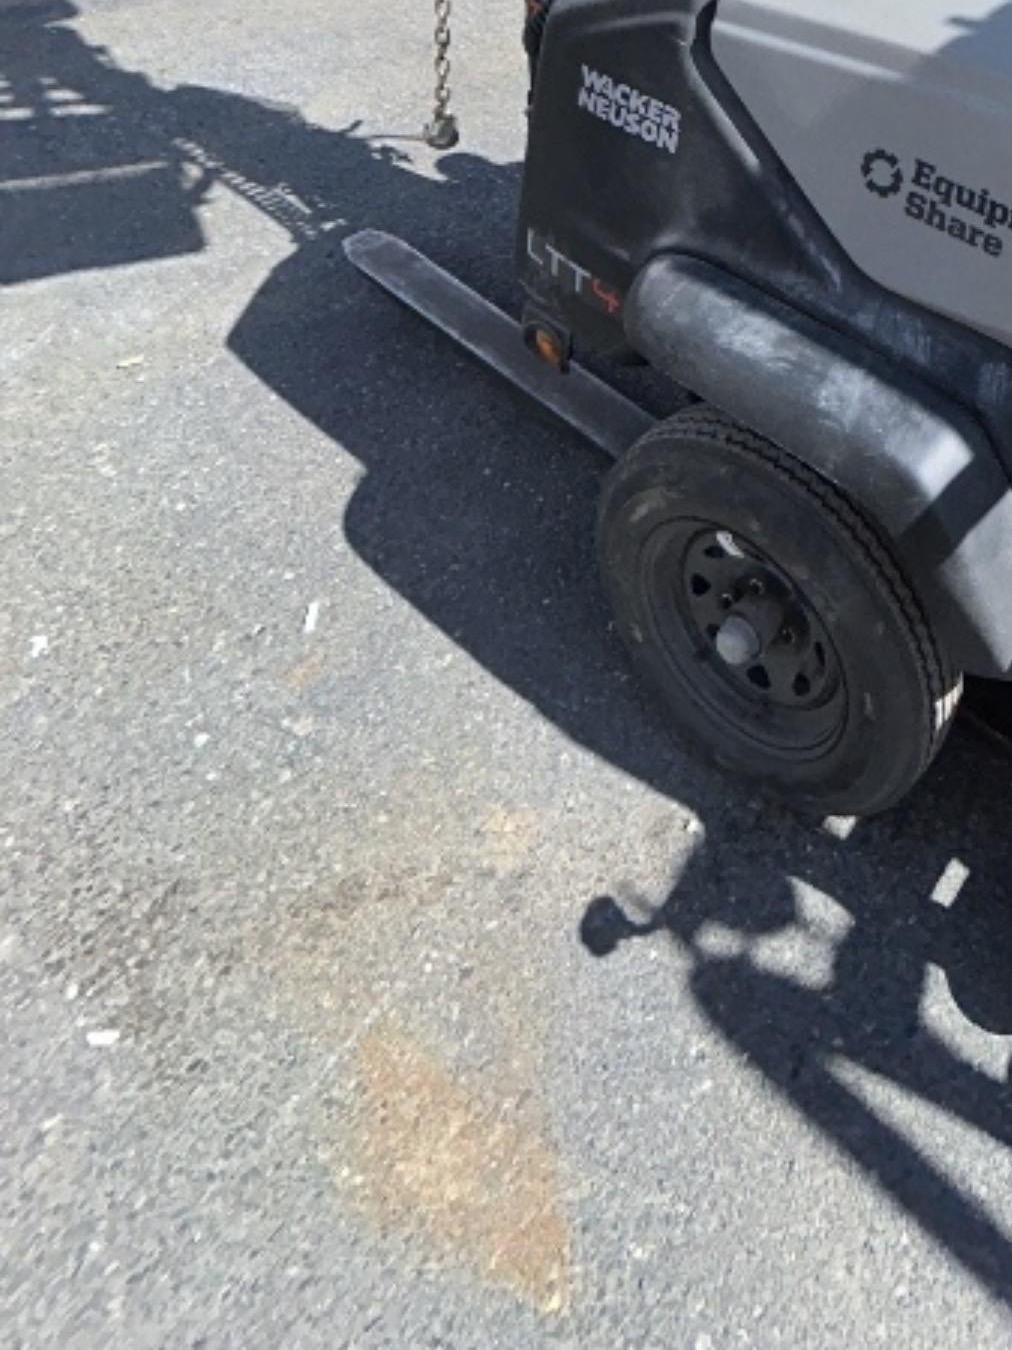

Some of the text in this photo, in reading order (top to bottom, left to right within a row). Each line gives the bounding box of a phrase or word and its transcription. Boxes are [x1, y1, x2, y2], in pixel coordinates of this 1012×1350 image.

[578, 86, 680, 154] NEUSON
[581, 62, 681, 131] WACKER
[904, 191, 1003, 257] Share
